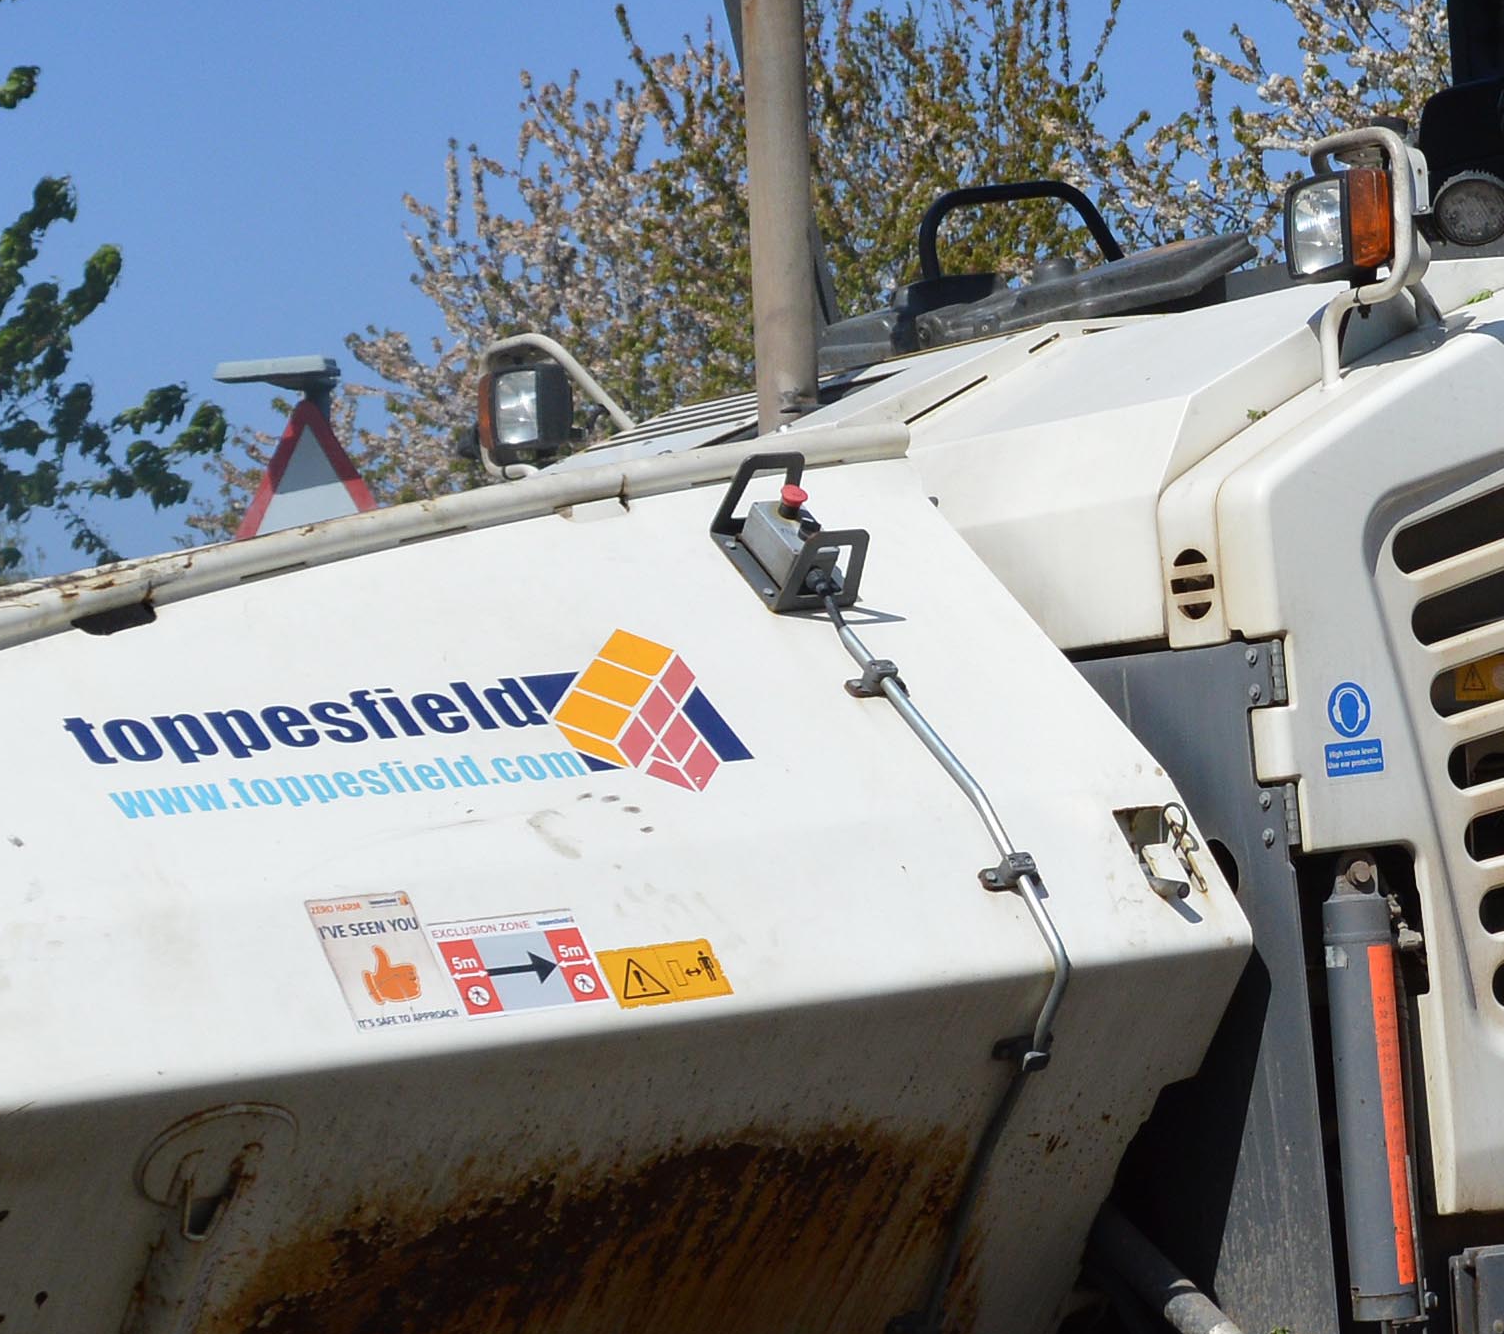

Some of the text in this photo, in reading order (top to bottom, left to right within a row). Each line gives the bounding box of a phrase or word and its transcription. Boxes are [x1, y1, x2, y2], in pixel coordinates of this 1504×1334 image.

[64, 677, 549, 765] toppesfield
[109, 751, 583, 819] www.toppesfield.com
[318, 917, 419, 939] I'VE SEEN YOU
[432, 920, 530, 939] EXCLUSION ZONE
[558, 945, 584, 959] 5m
[451, 957, 478, 971] 5m
[376, 1015, 399, 1026] SAFE
[399, 1014, 411, 1023] TO
[413, 1009, 459, 1022] APPROACH
